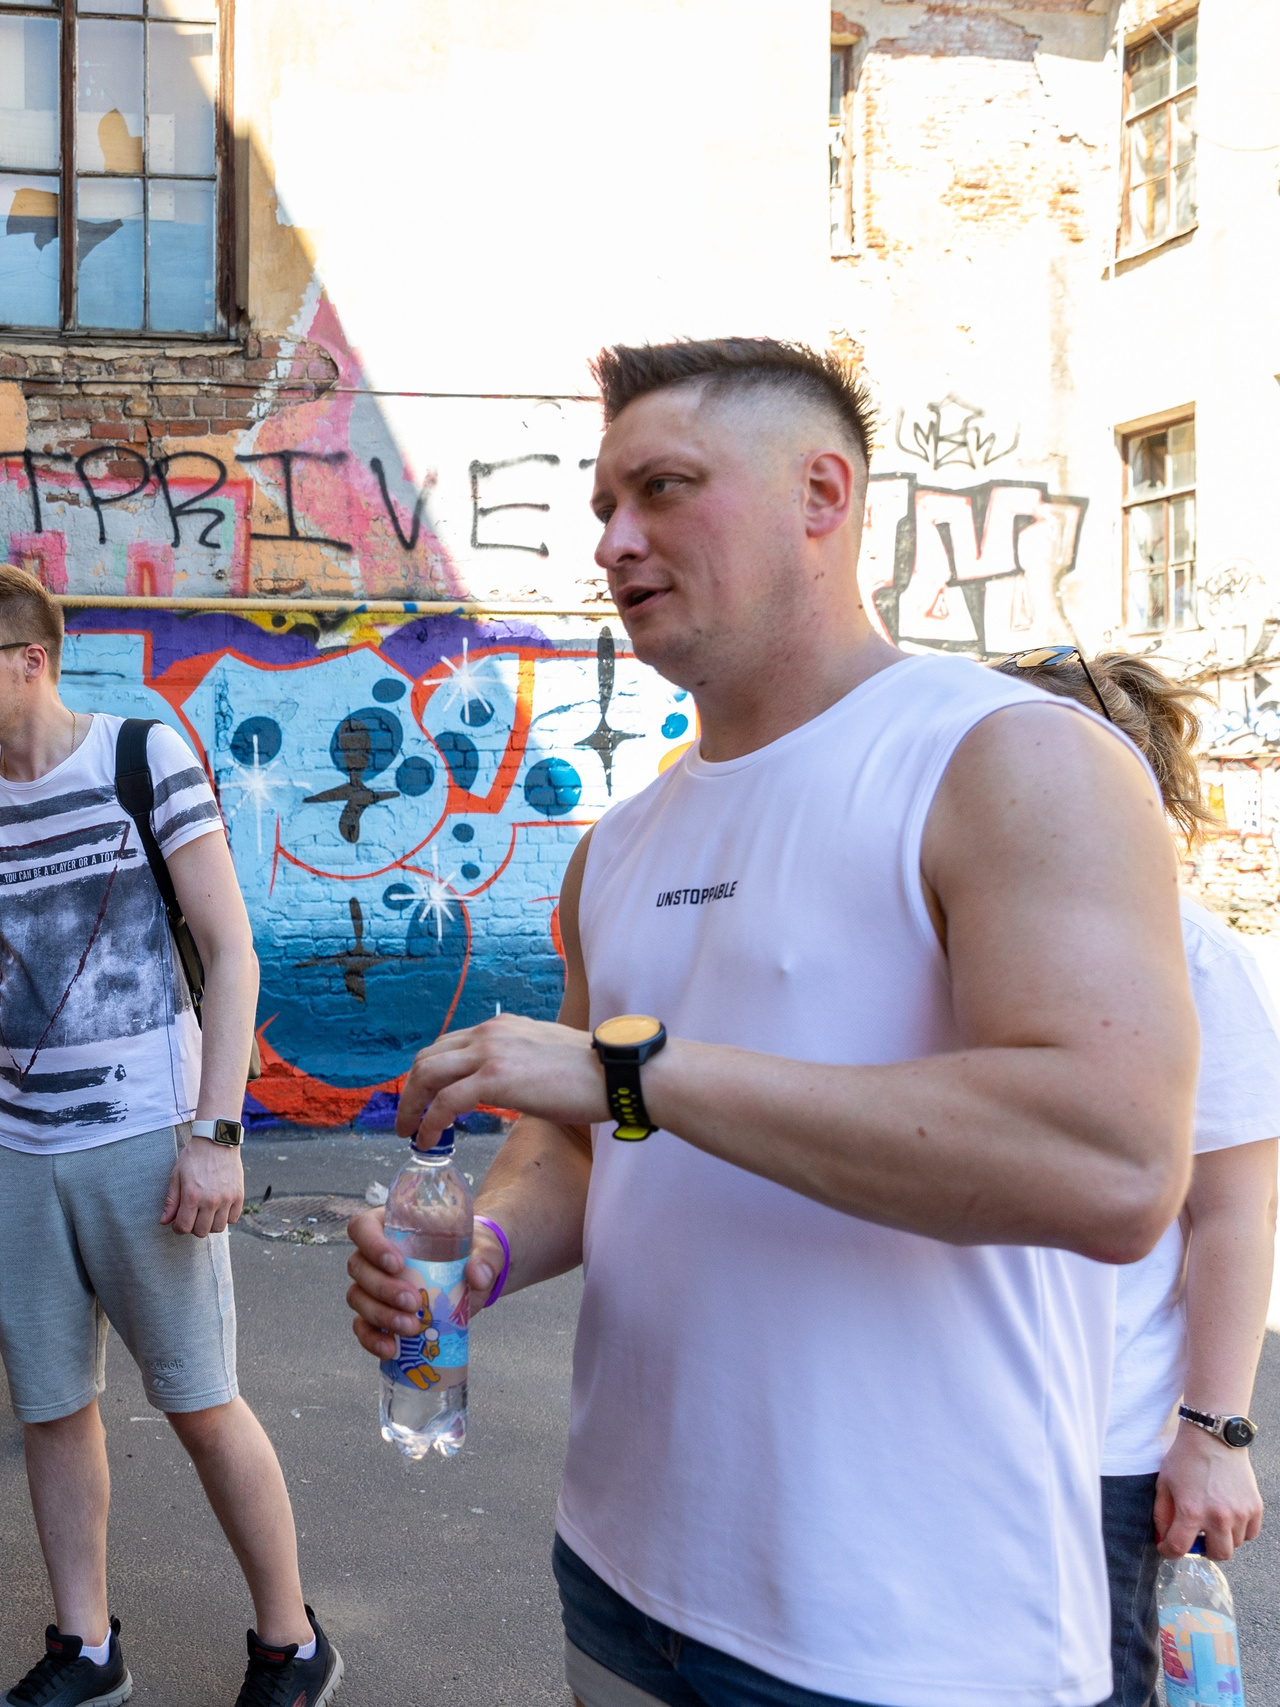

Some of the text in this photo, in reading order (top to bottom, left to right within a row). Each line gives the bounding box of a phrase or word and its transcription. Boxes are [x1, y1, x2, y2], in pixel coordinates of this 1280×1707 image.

[75, 444, 596, 558] PRIVE
[4, 873, 17, 884] YOU
[19, 870, 32, 881] CAN
[33, 867, 42, 878] BE
[44, 866, 49, 876] A
[51, 860, 76, 875] PLAYER
[78, 858, 89, 868] OR
[91, 855, 97, 865] A
[656, 880, 738, 908] UNSTOPPABLE
